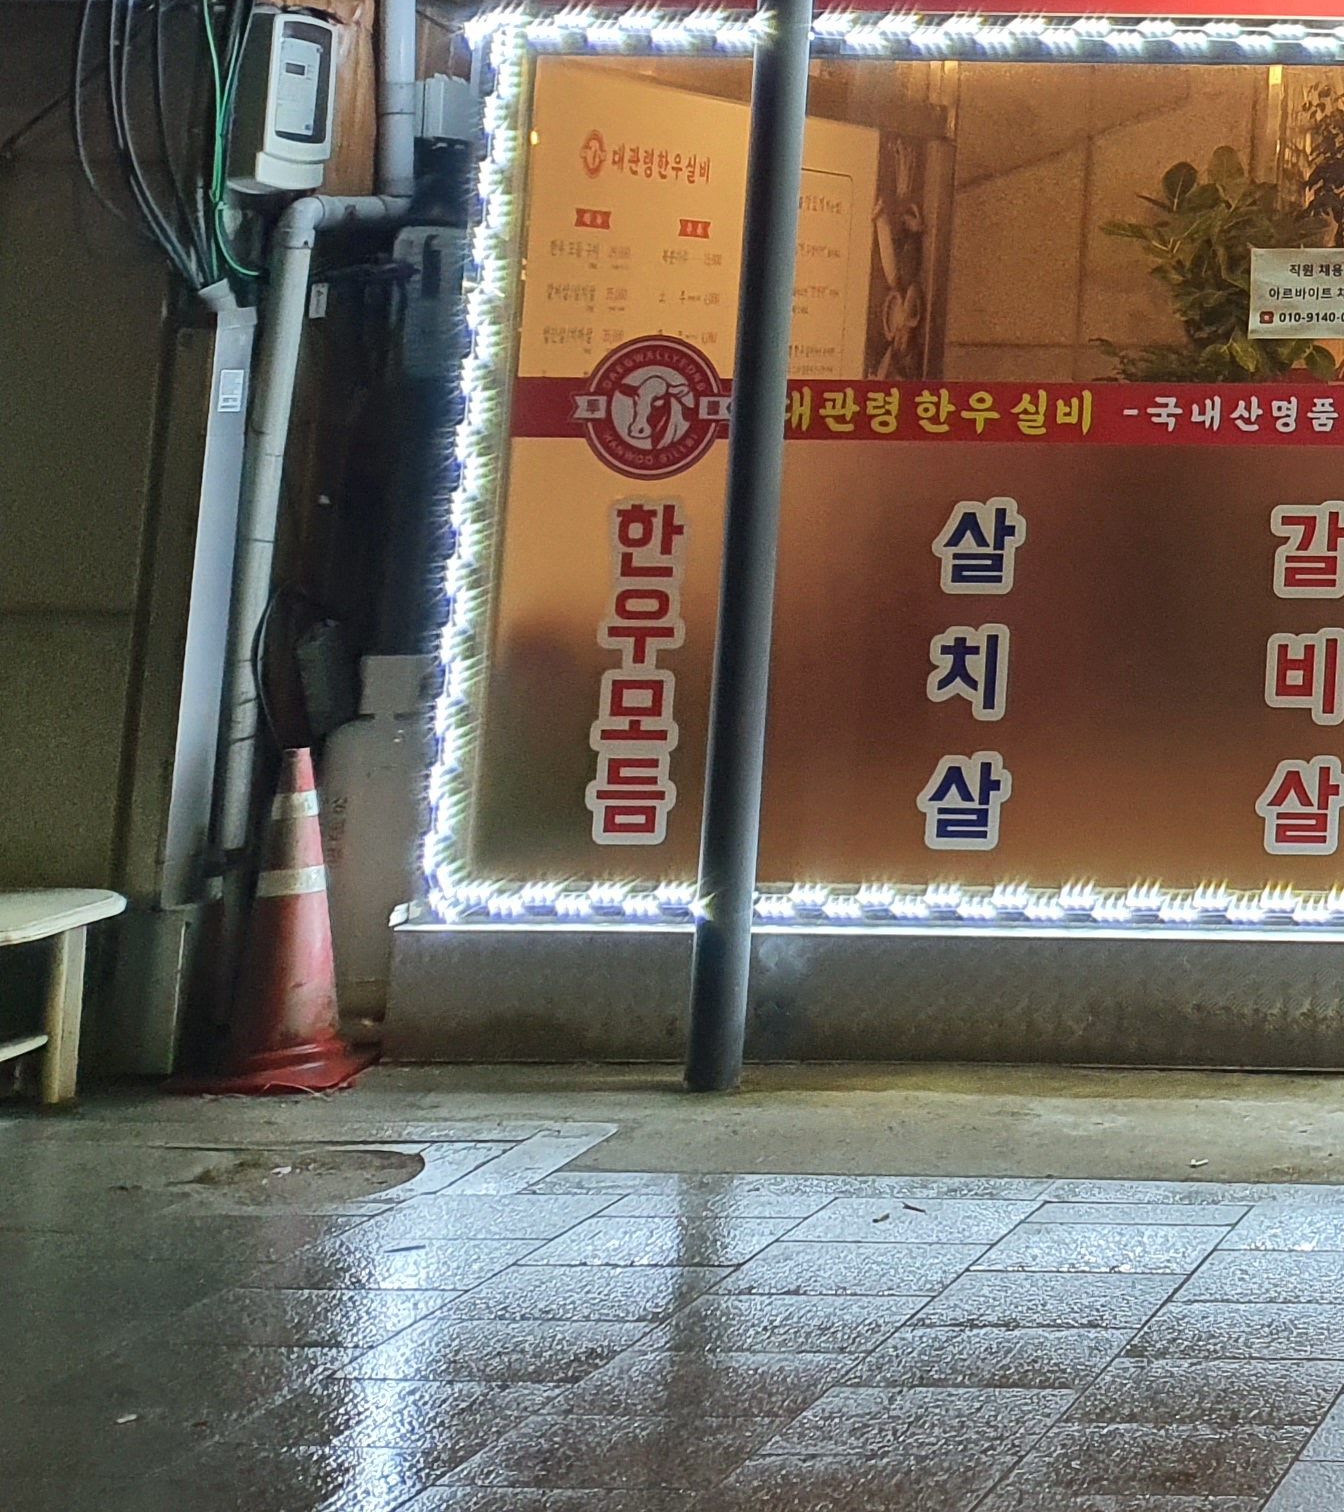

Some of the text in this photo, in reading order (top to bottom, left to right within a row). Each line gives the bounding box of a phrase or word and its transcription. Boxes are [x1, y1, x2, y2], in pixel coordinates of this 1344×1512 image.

[1268, 286, 1333, 301] 아르바이트
[1288, 262, 1344, 278] 직원 채용
[785, 386, 900, 434] 대관령
[915, 388, 1001, 435] 한우
[1010, 388, 1093, 436] 실비
[594, 502, 686, 835] 한우모듬
[926, 506, 1018, 841] 살치살
